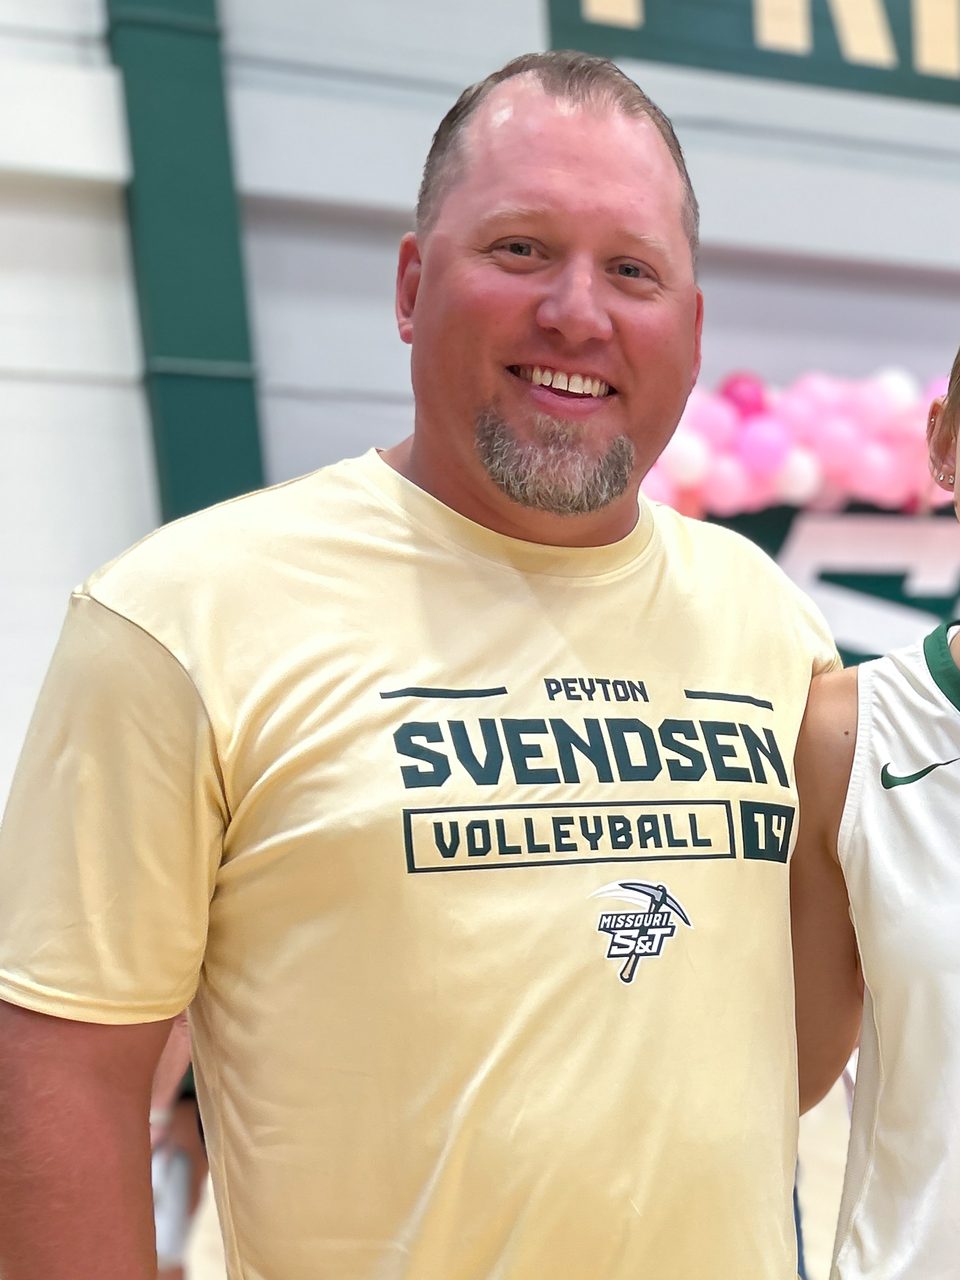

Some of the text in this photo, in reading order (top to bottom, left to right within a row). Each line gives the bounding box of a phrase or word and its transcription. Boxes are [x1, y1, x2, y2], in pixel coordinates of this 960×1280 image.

[543, 678, 650, 703] PEYTON
[393, 718, 790, 789] SVENDSEN
[433, 812, 787, 858] VOLLEYBALL 14
[600, 913, 670, 929] MISSOURI
[608, 927, 672, 956] S&T
